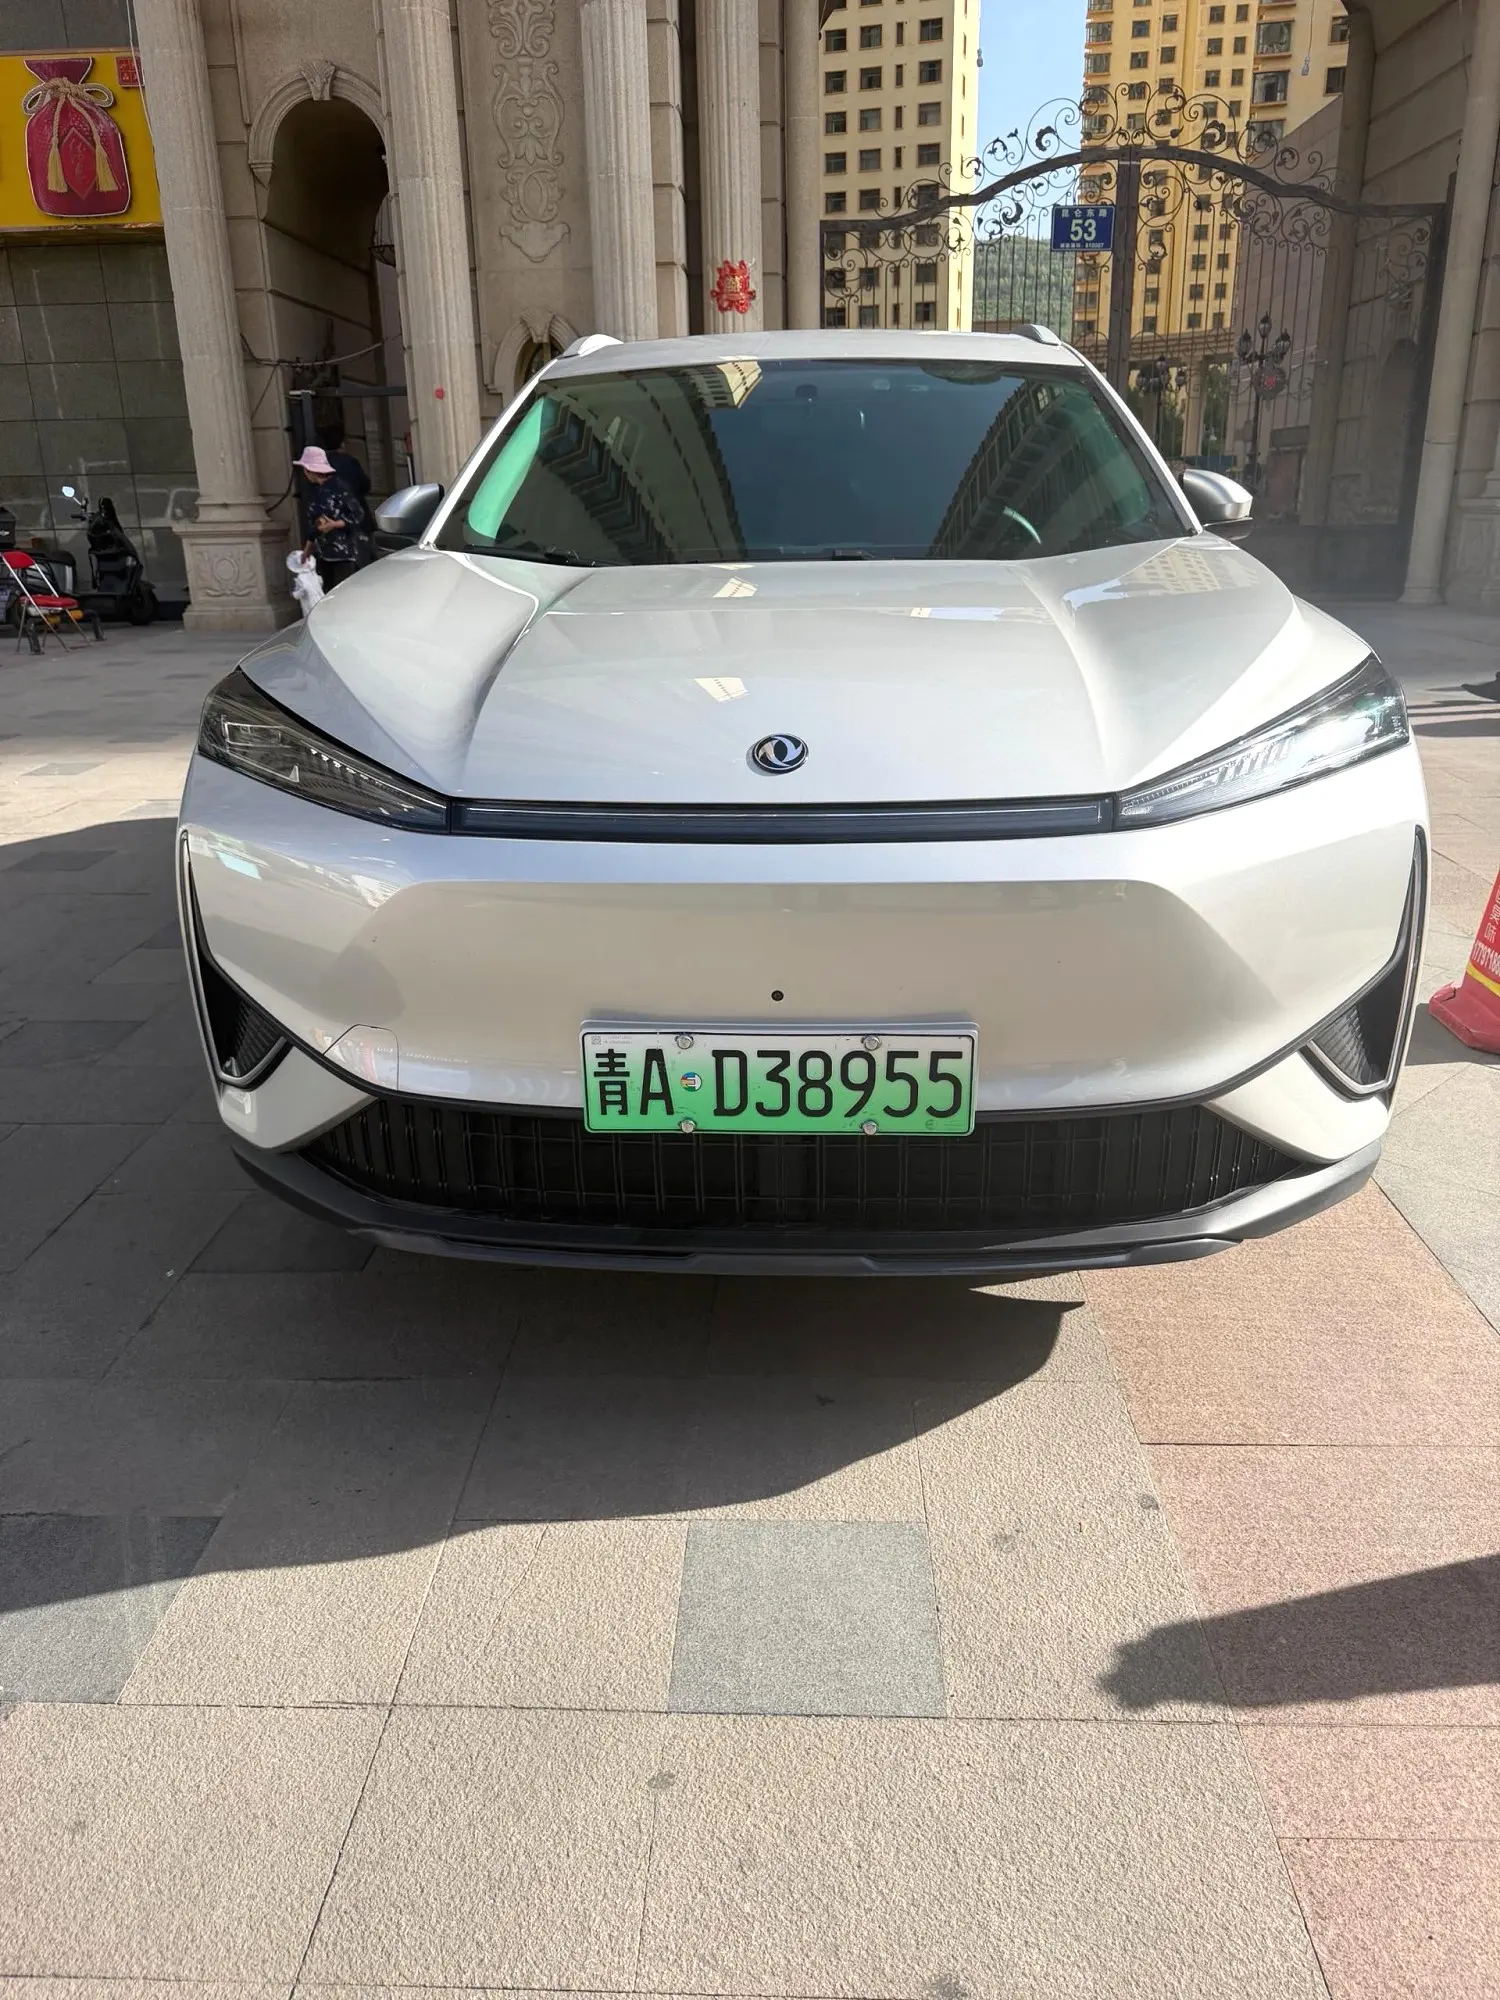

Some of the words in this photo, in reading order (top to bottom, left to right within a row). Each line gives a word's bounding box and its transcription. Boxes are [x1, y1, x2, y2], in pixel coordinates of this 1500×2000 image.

[1069, 218, 1097, 241] 53
[593, 1047, 675, 1116] 青A
[711, 1049, 963, 1118] D38955
